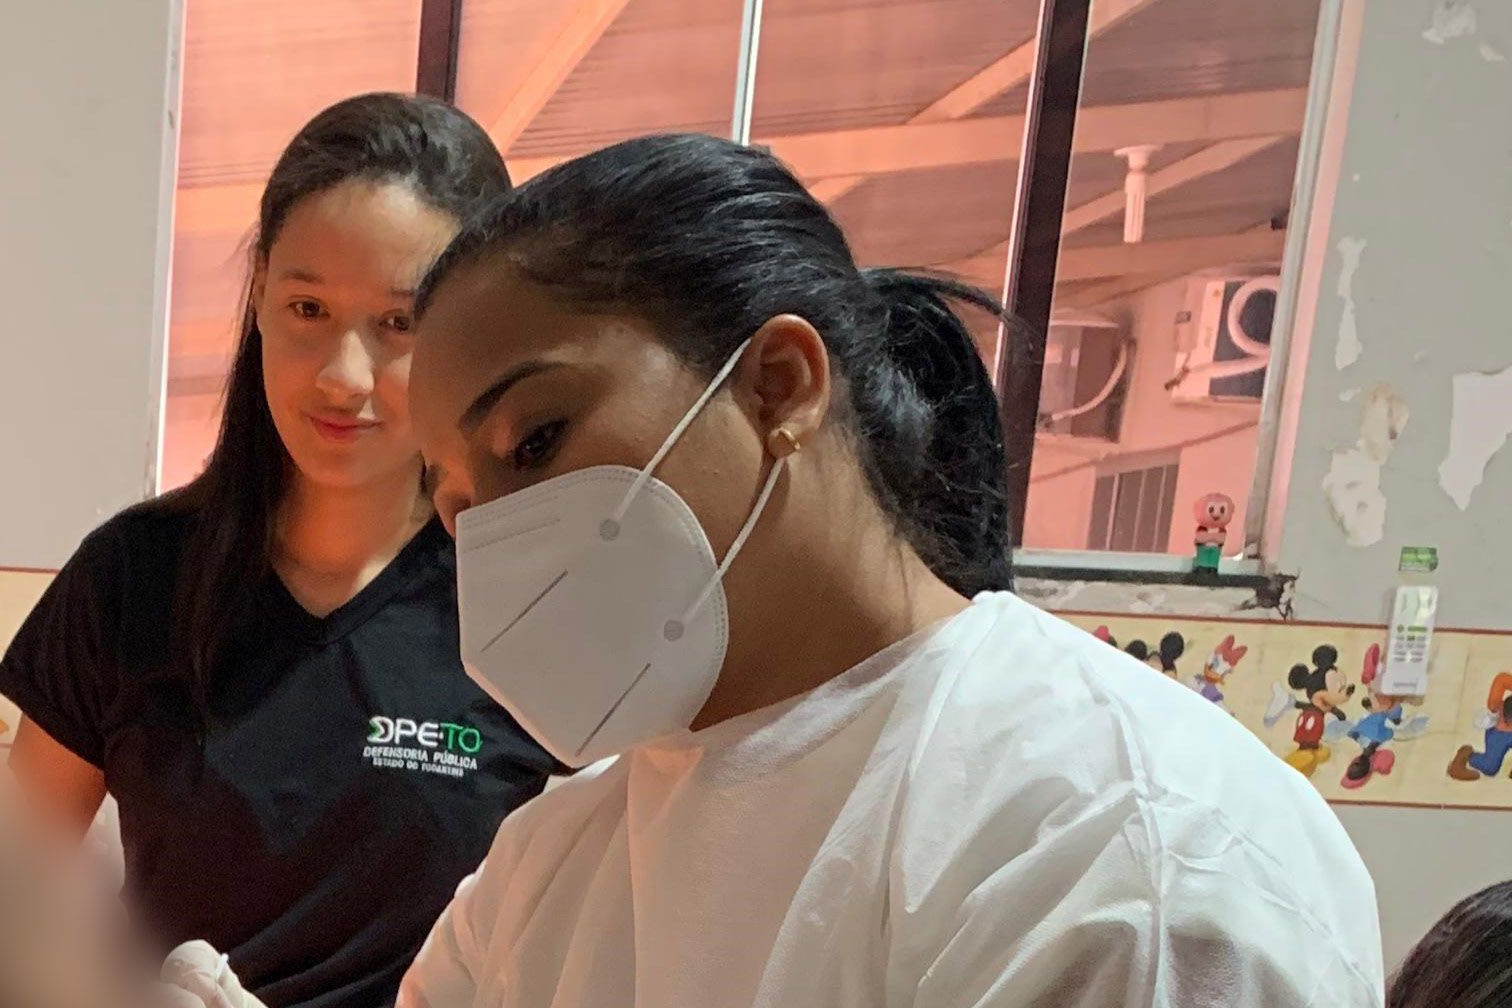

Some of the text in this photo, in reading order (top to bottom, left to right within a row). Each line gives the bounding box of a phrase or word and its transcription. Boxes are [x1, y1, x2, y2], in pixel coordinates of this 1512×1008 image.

[363, 746, 477, 770] DEFENSORIA PÚBLICA
[373, 757, 404, 768] ESTADO
